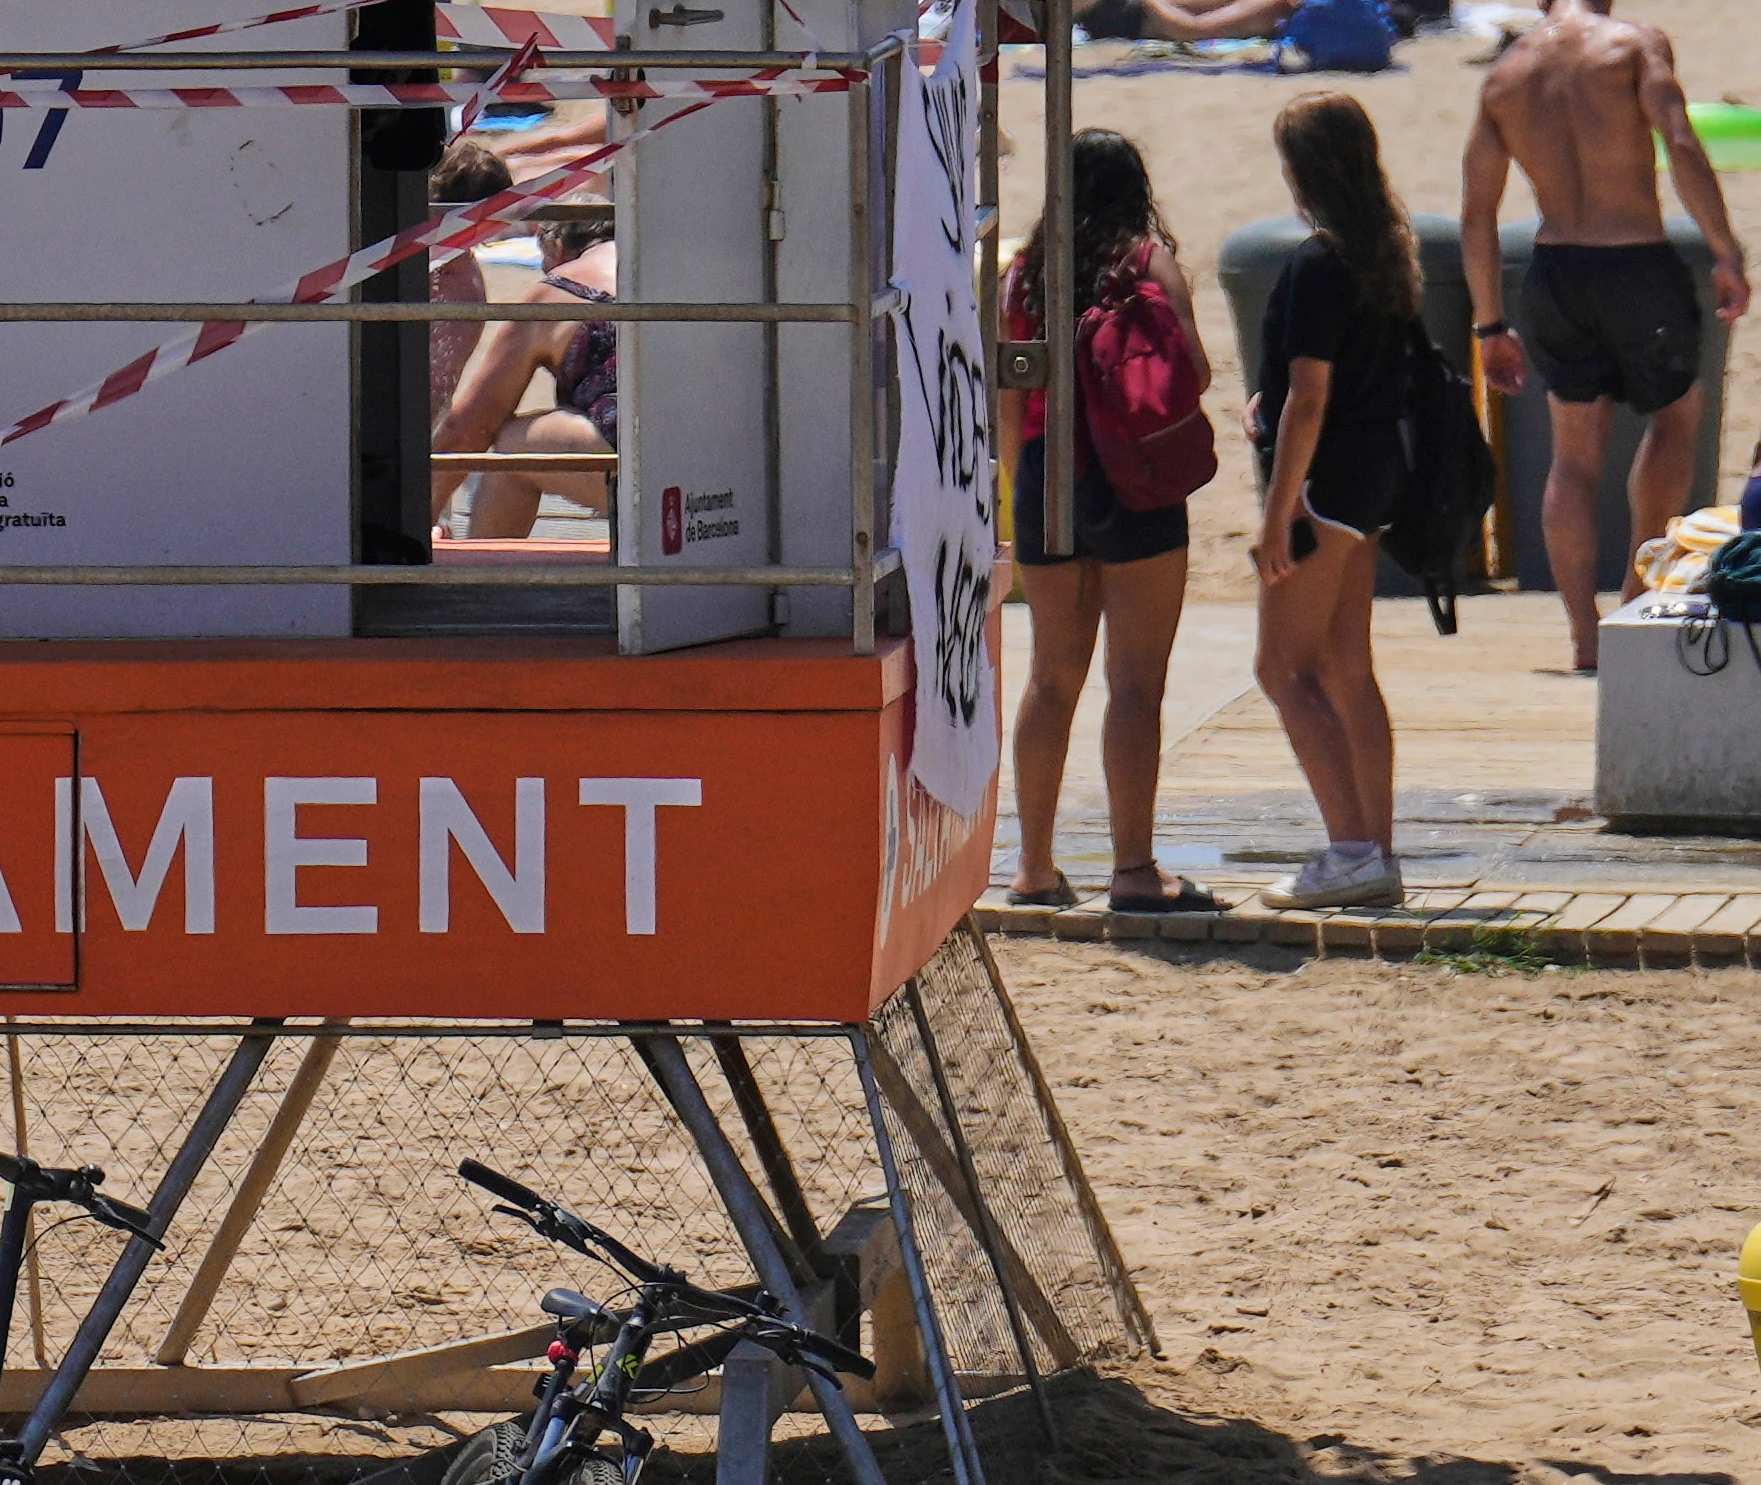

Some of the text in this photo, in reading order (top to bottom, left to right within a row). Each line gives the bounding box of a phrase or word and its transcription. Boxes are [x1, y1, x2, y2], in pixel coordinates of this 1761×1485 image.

[684, 488, 734, 520] Ajuntament
[685, 516, 740, 543] de Barcelona
